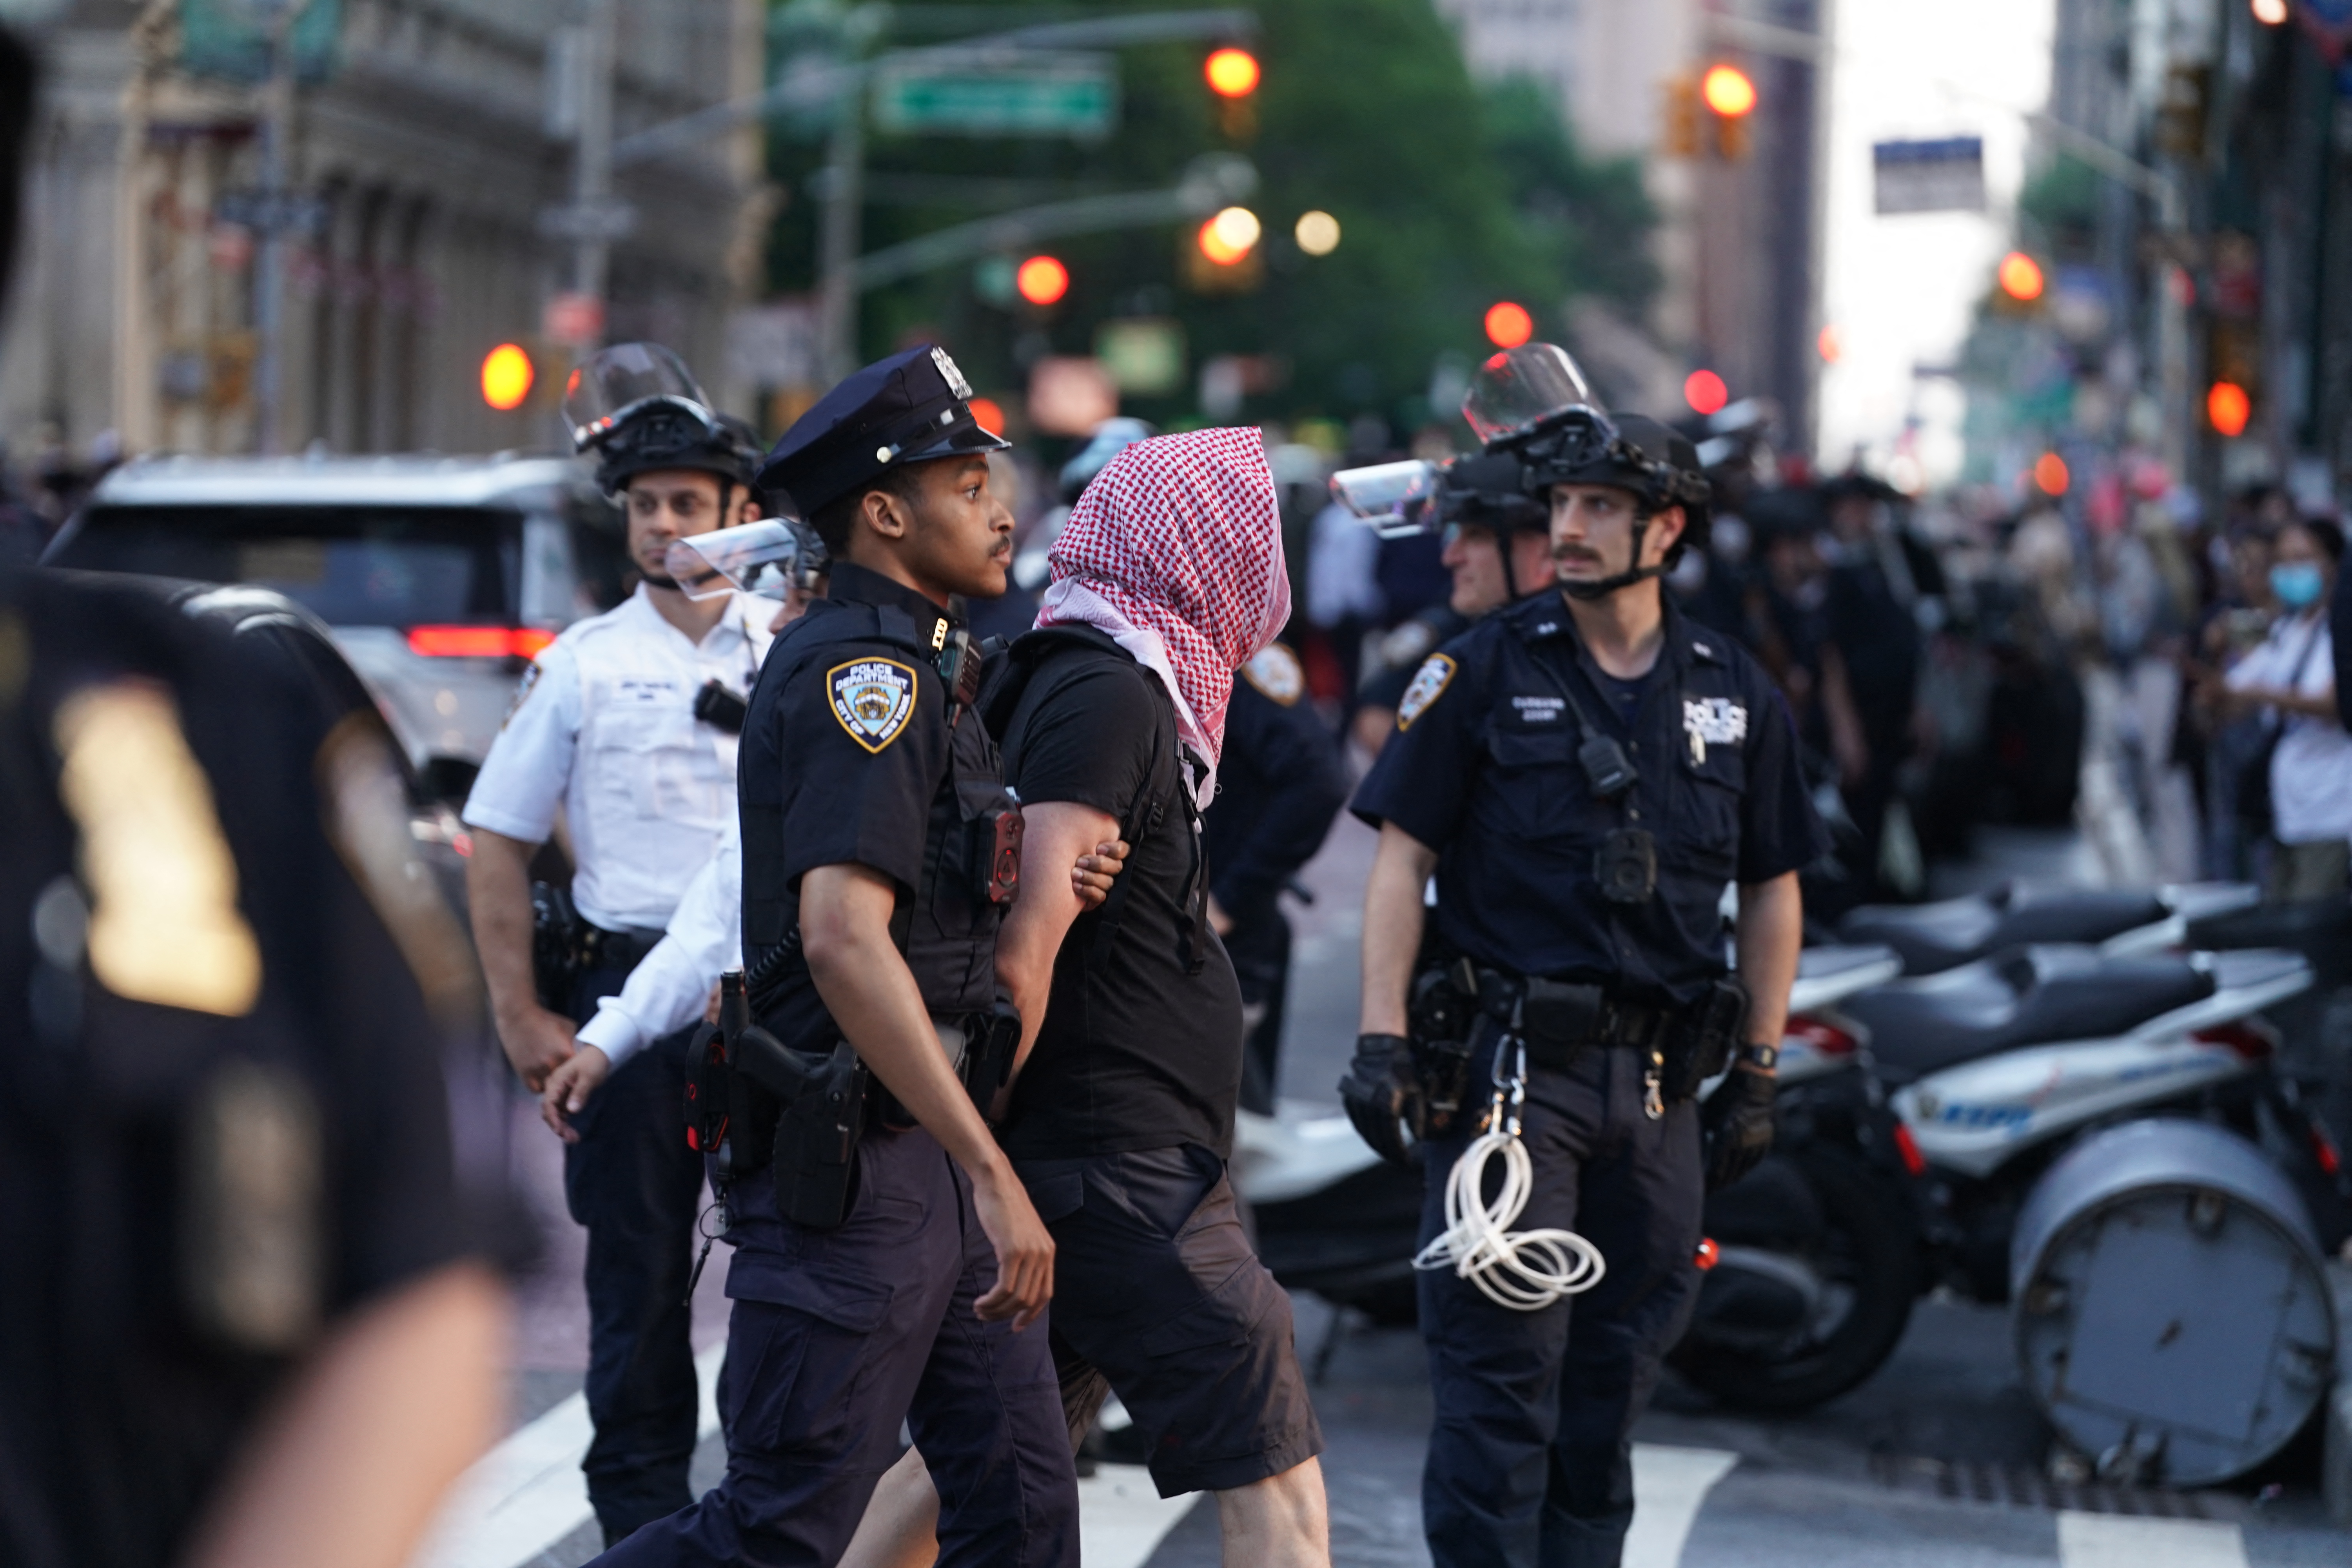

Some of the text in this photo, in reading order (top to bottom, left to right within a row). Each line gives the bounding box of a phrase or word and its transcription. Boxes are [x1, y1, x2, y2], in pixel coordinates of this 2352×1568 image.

[850, 662, 893, 675] POLICE
[835, 673, 909, 692] DEPARTMENT
[836, 699, 865, 735] CITY OF
[879, 693, 911, 740] NEW YORK
